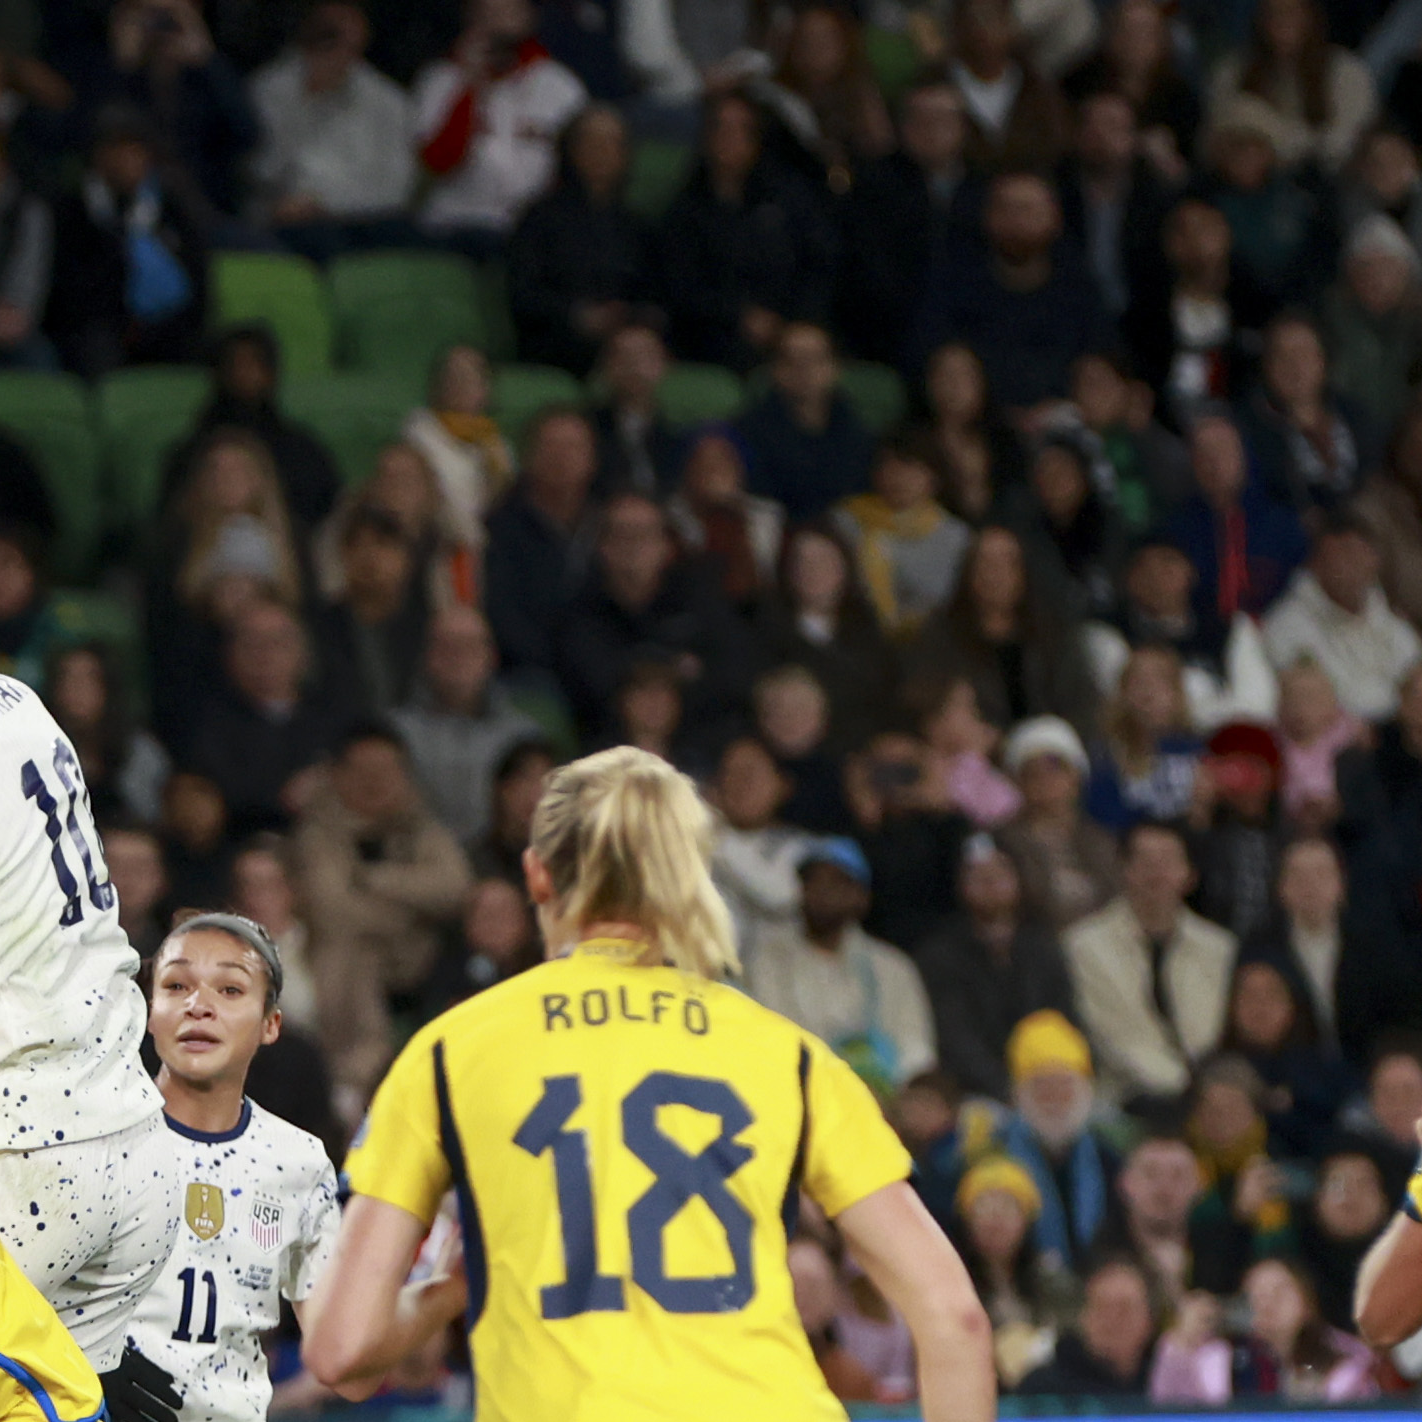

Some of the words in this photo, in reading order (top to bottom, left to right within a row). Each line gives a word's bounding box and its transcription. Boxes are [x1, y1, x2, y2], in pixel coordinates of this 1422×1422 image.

[21, 737, 114, 929] 10
[542, 985, 709, 1036] ROLFÖ
[252, 1203, 280, 1226] USA
[512, 1070, 757, 1321] 18
[171, 1266, 218, 1344] 11
